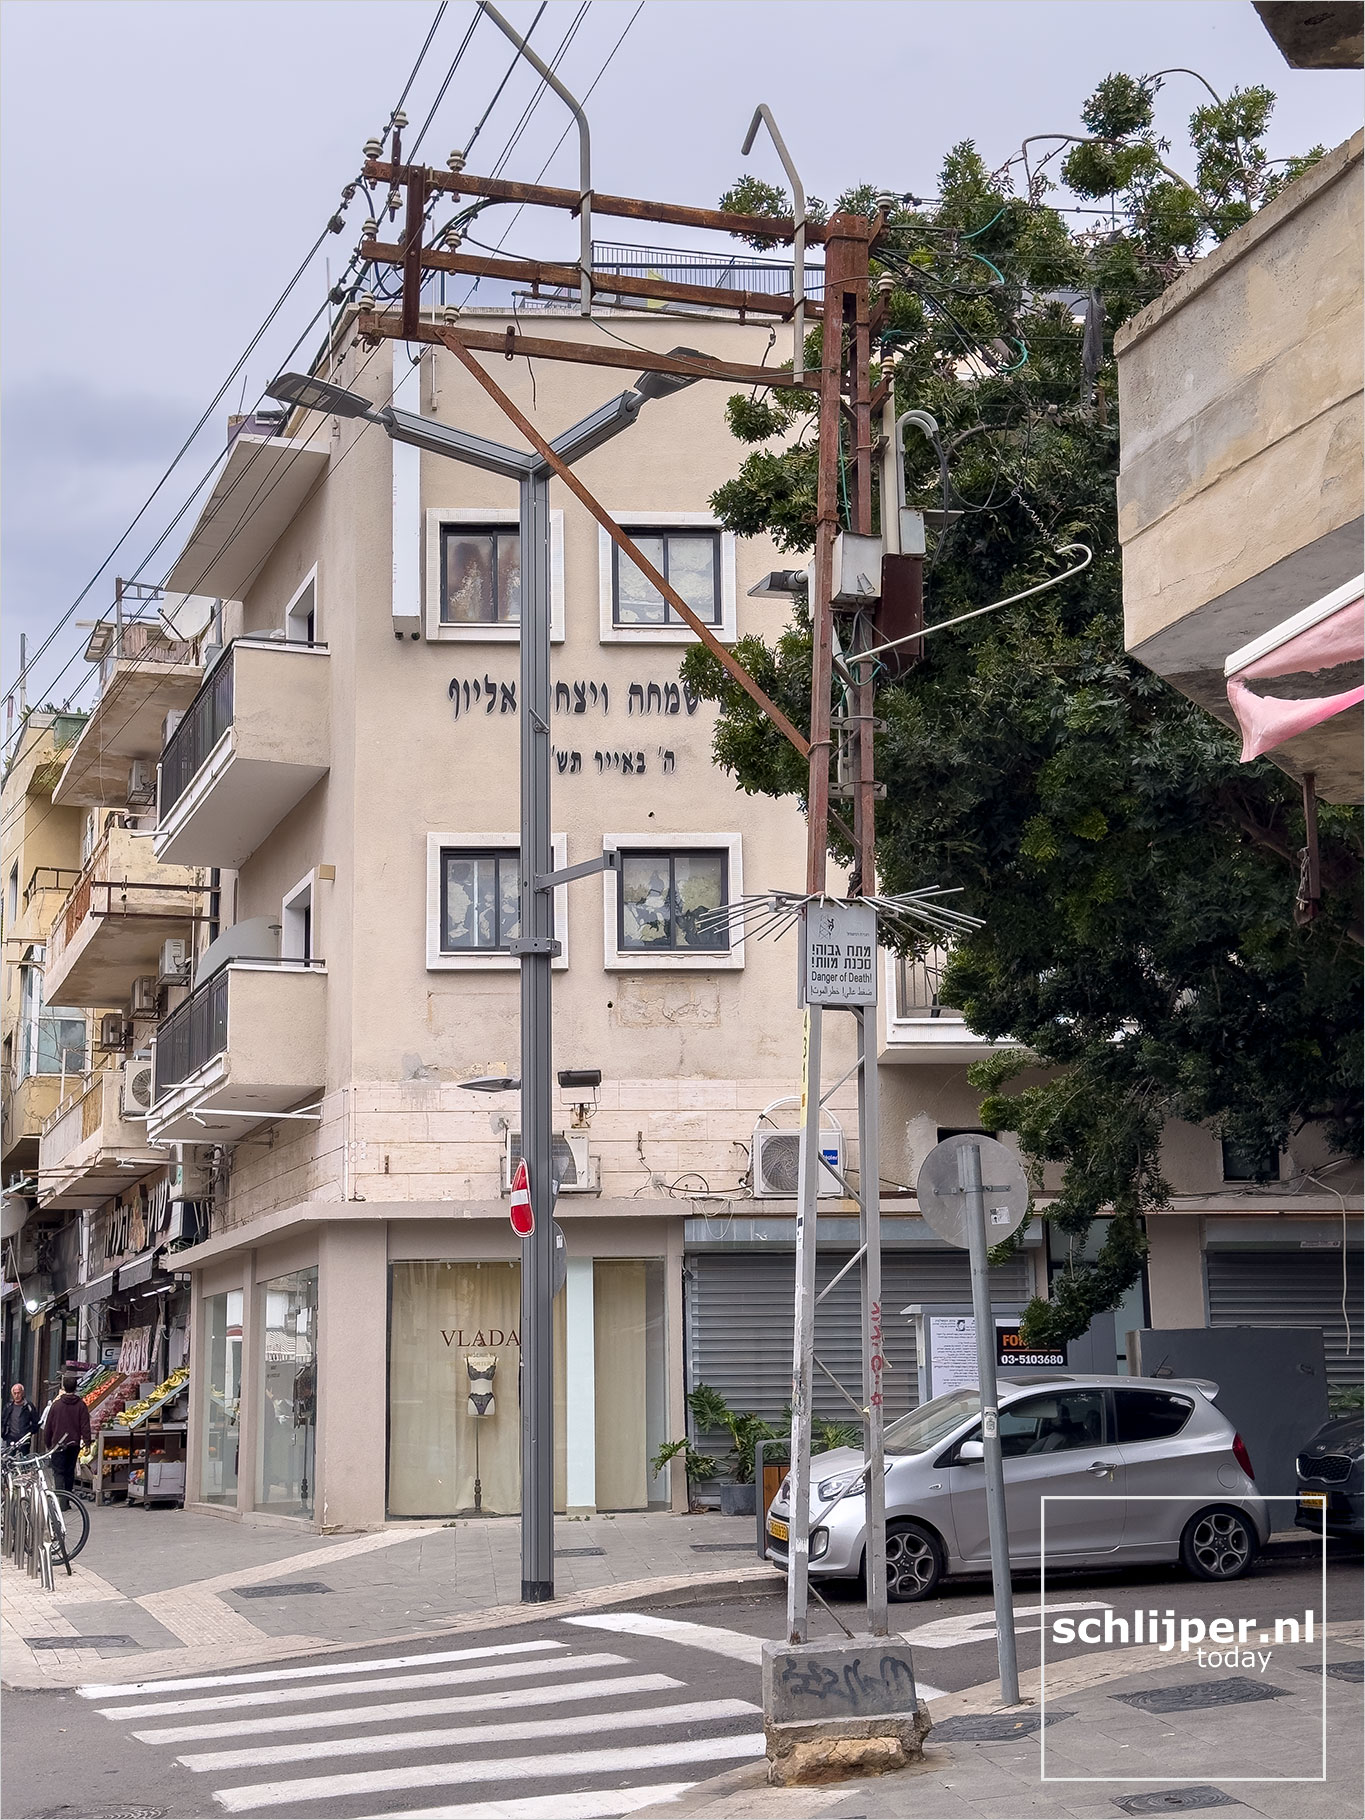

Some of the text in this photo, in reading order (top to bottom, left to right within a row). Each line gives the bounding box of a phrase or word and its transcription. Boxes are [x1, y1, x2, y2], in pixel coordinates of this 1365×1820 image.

[447, 673, 700, 722] שמחה ויצח אליוף
[593, 749, 646, 776] באייר
[812, 944, 871, 956] מתח גבוה!
[812, 957, 871, 970] סכנת מוות!
[812, 971, 872, 984] Danger of Death!
[440, 1329, 521, 1347] VLADA
[1001, 1354, 1064, 1365] 03-5103680
